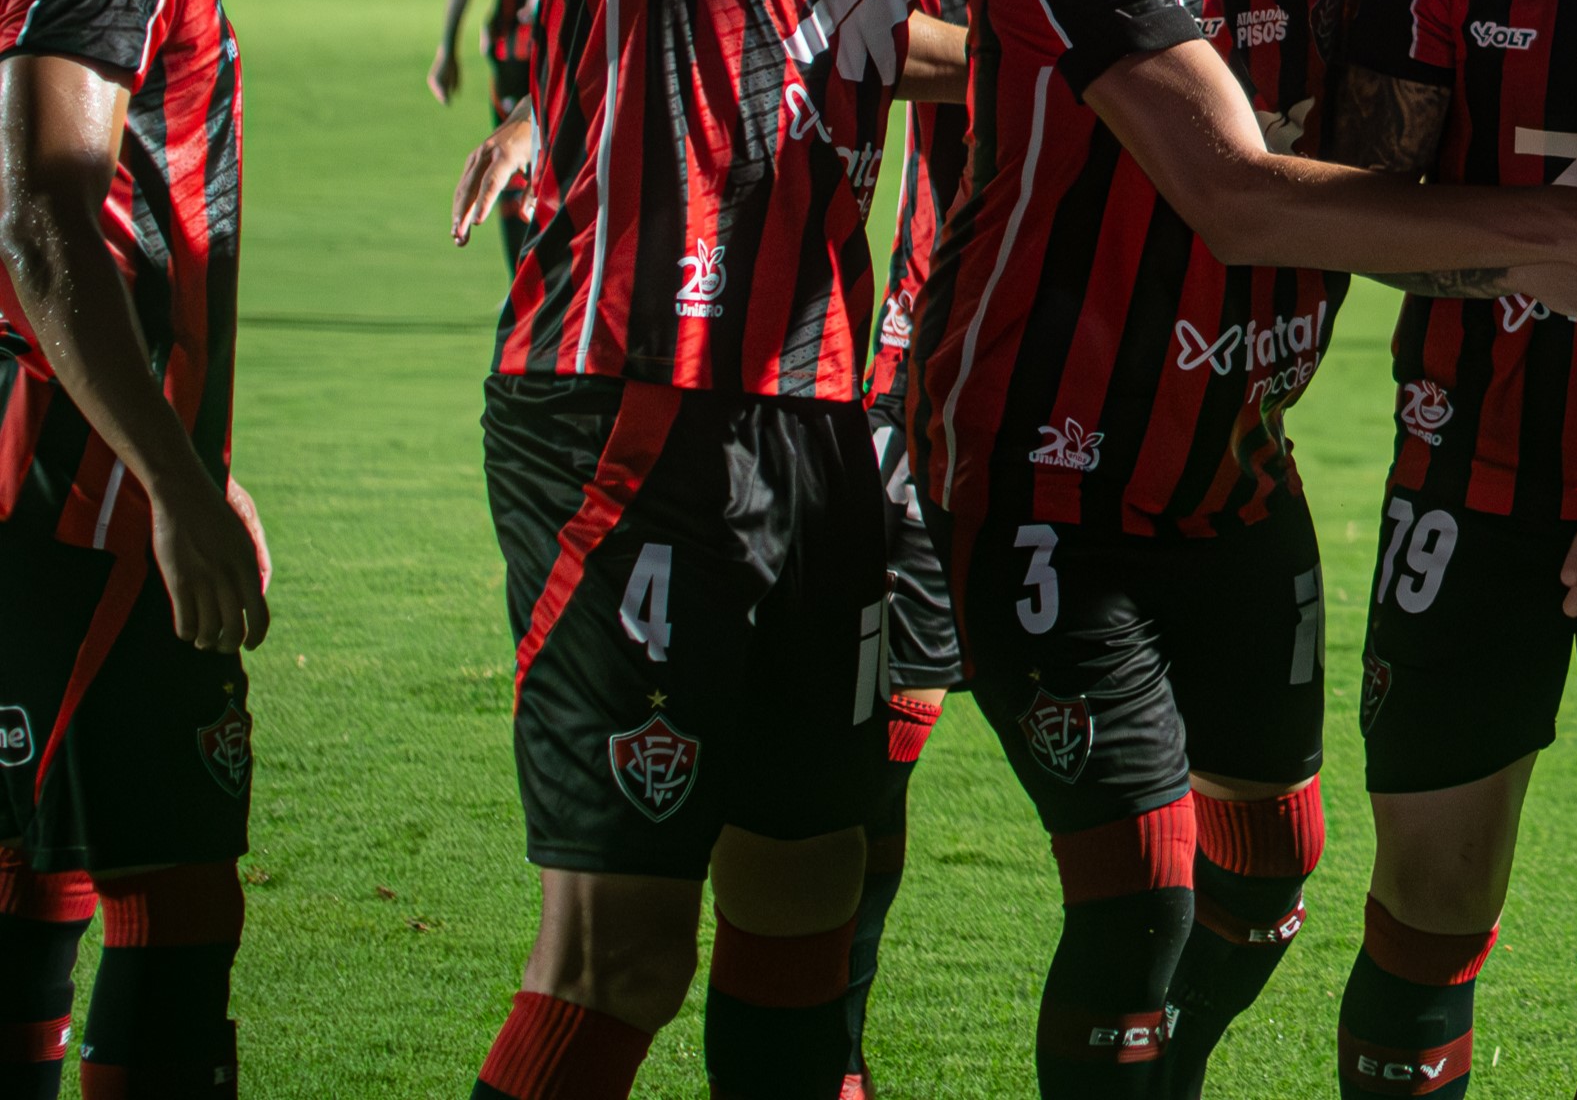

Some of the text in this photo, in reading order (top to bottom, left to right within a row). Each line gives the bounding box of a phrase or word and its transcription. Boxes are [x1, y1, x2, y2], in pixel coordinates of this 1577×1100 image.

[1237, 5, 1290, 27] ATACADÃO
[1237, 21, 1288, 49] PISOS
[1470, 21, 1537, 49] VOLT
[1244, 300, 1327, 371] fatal
[1014, 524, 1060, 635] 3
[619, 542, 673, 662] 4
[1357, 1054, 1447, 1079] ECV
